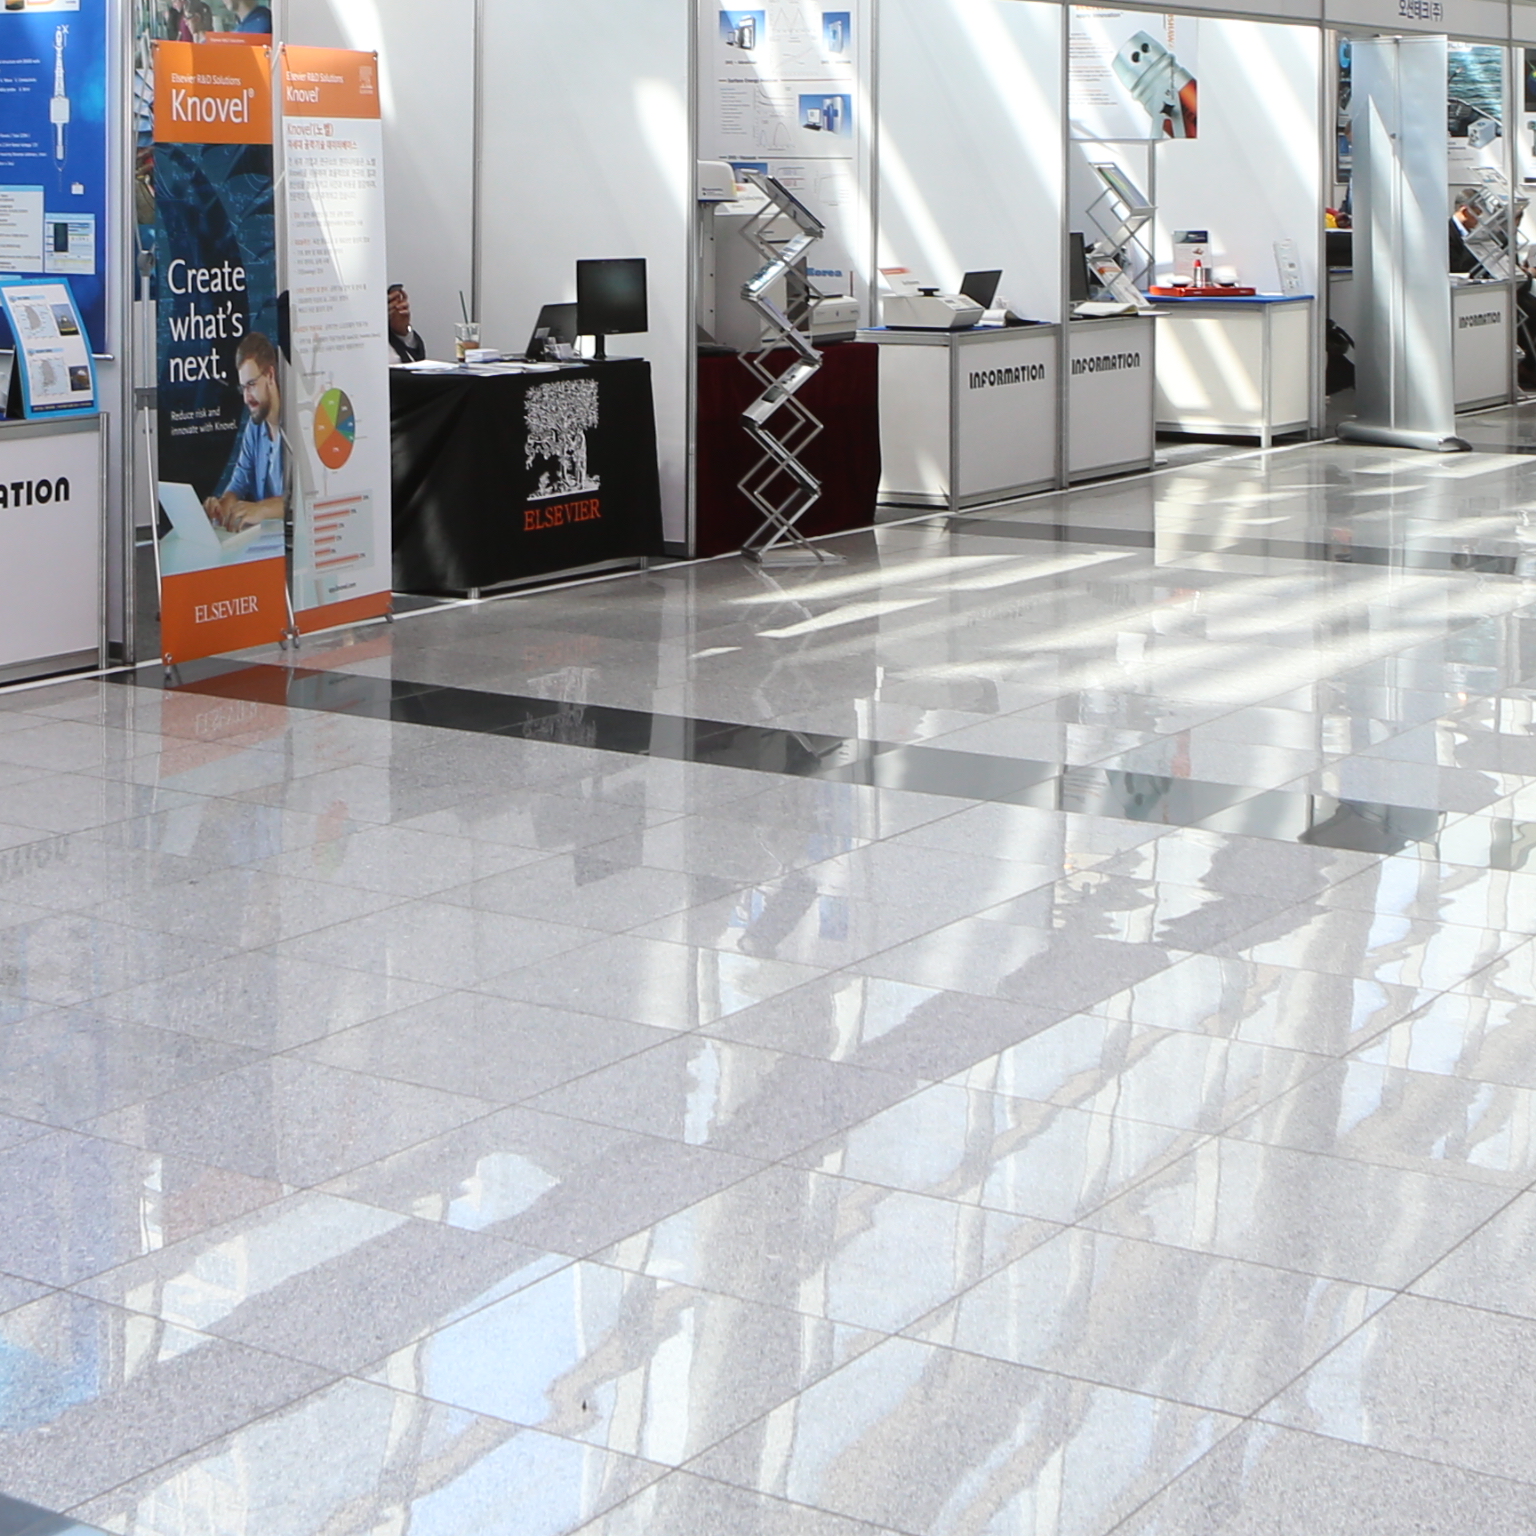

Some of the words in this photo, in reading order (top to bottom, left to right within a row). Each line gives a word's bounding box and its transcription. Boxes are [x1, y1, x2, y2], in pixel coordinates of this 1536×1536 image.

[171, 72, 196, 84] Elsevier
[196, 74, 211, 85] R&D
[212, 74, 242, 86] Solutions
[167, 258, 246, 294] Create
[169, 301, 244, 343] what's
[169, 347, 228, 383] next.
[969, 363, 1046, 390] INFORMATION
[1072, 352, 1141, 376] INFORMATION
[208, 406, 221, 417] and
[523, 497, 601, 533] ELSEVIER
[194, 594, 260, 625] ELSEVIER
